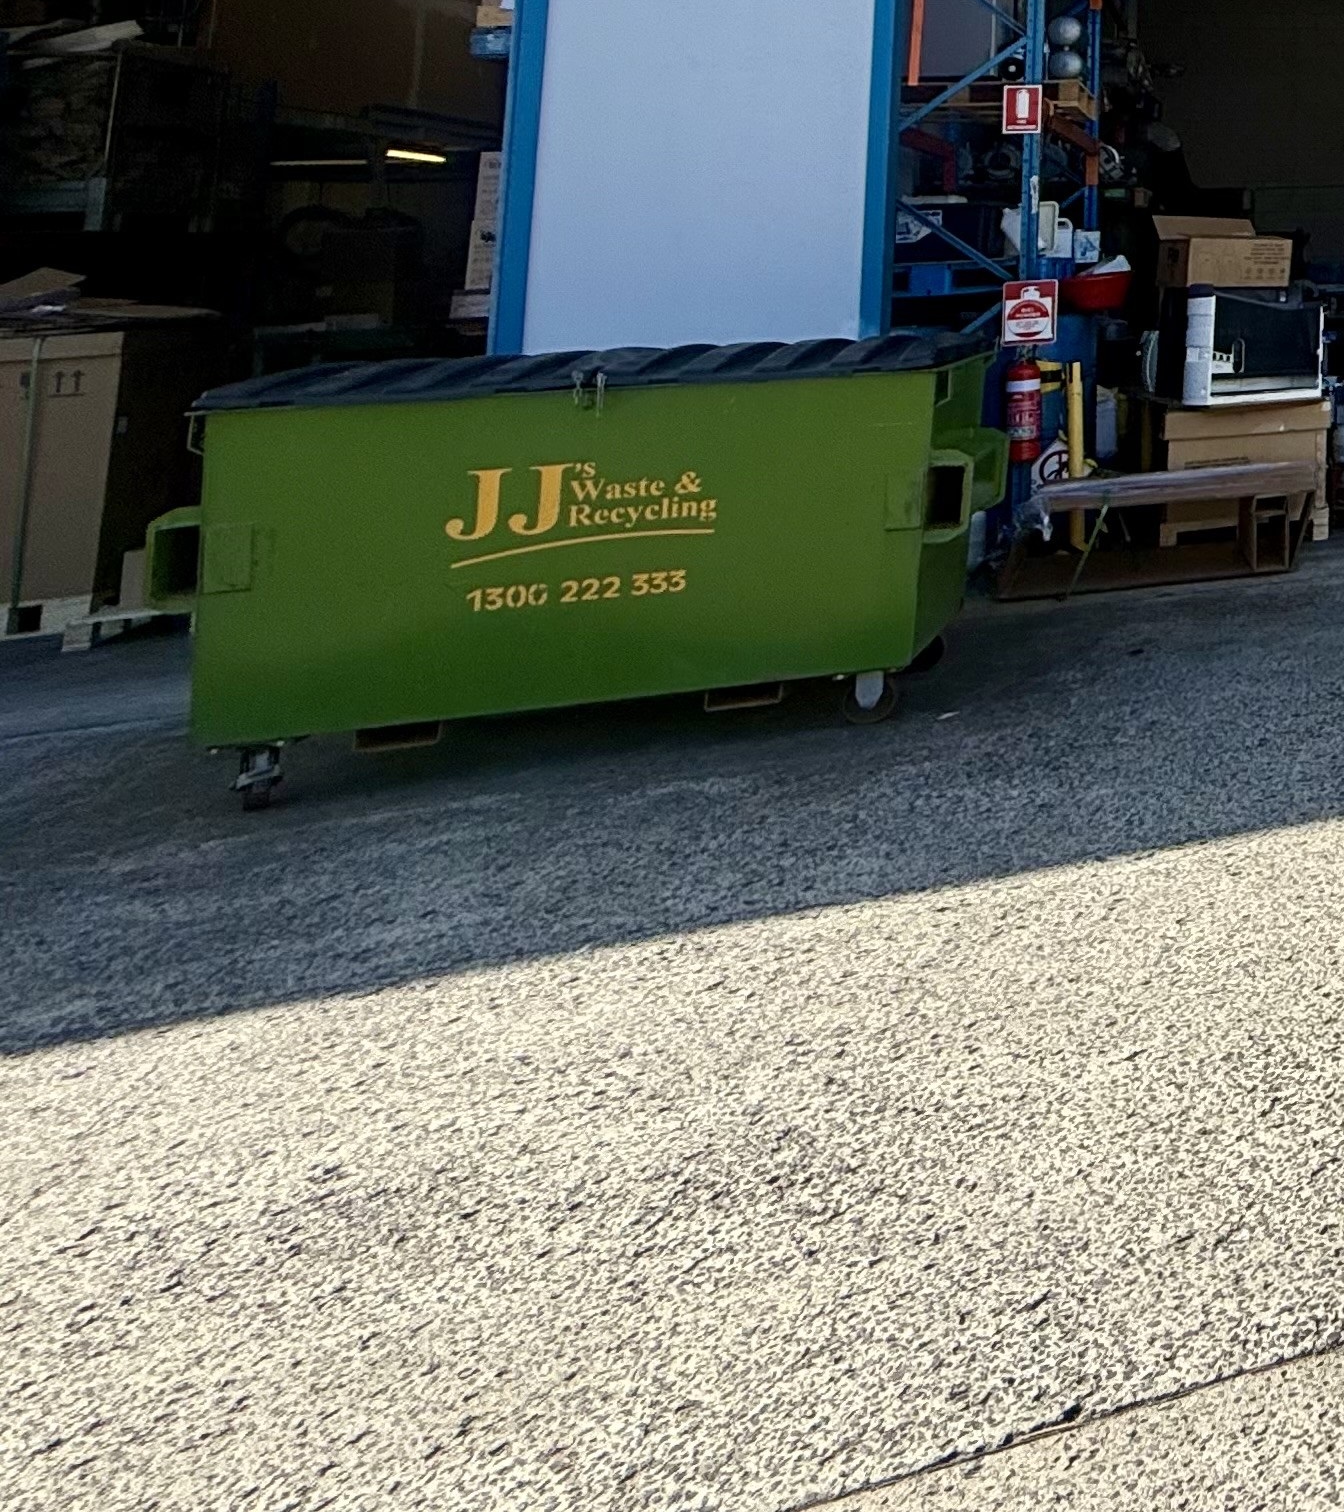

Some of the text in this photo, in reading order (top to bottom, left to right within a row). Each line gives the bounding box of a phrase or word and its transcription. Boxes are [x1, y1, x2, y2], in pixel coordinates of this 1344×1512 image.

[570, 471, 703, 502] Waste &
[569, 496, 717, 528] Recycling
[466, 568, 687, 612] 1300 222 333
